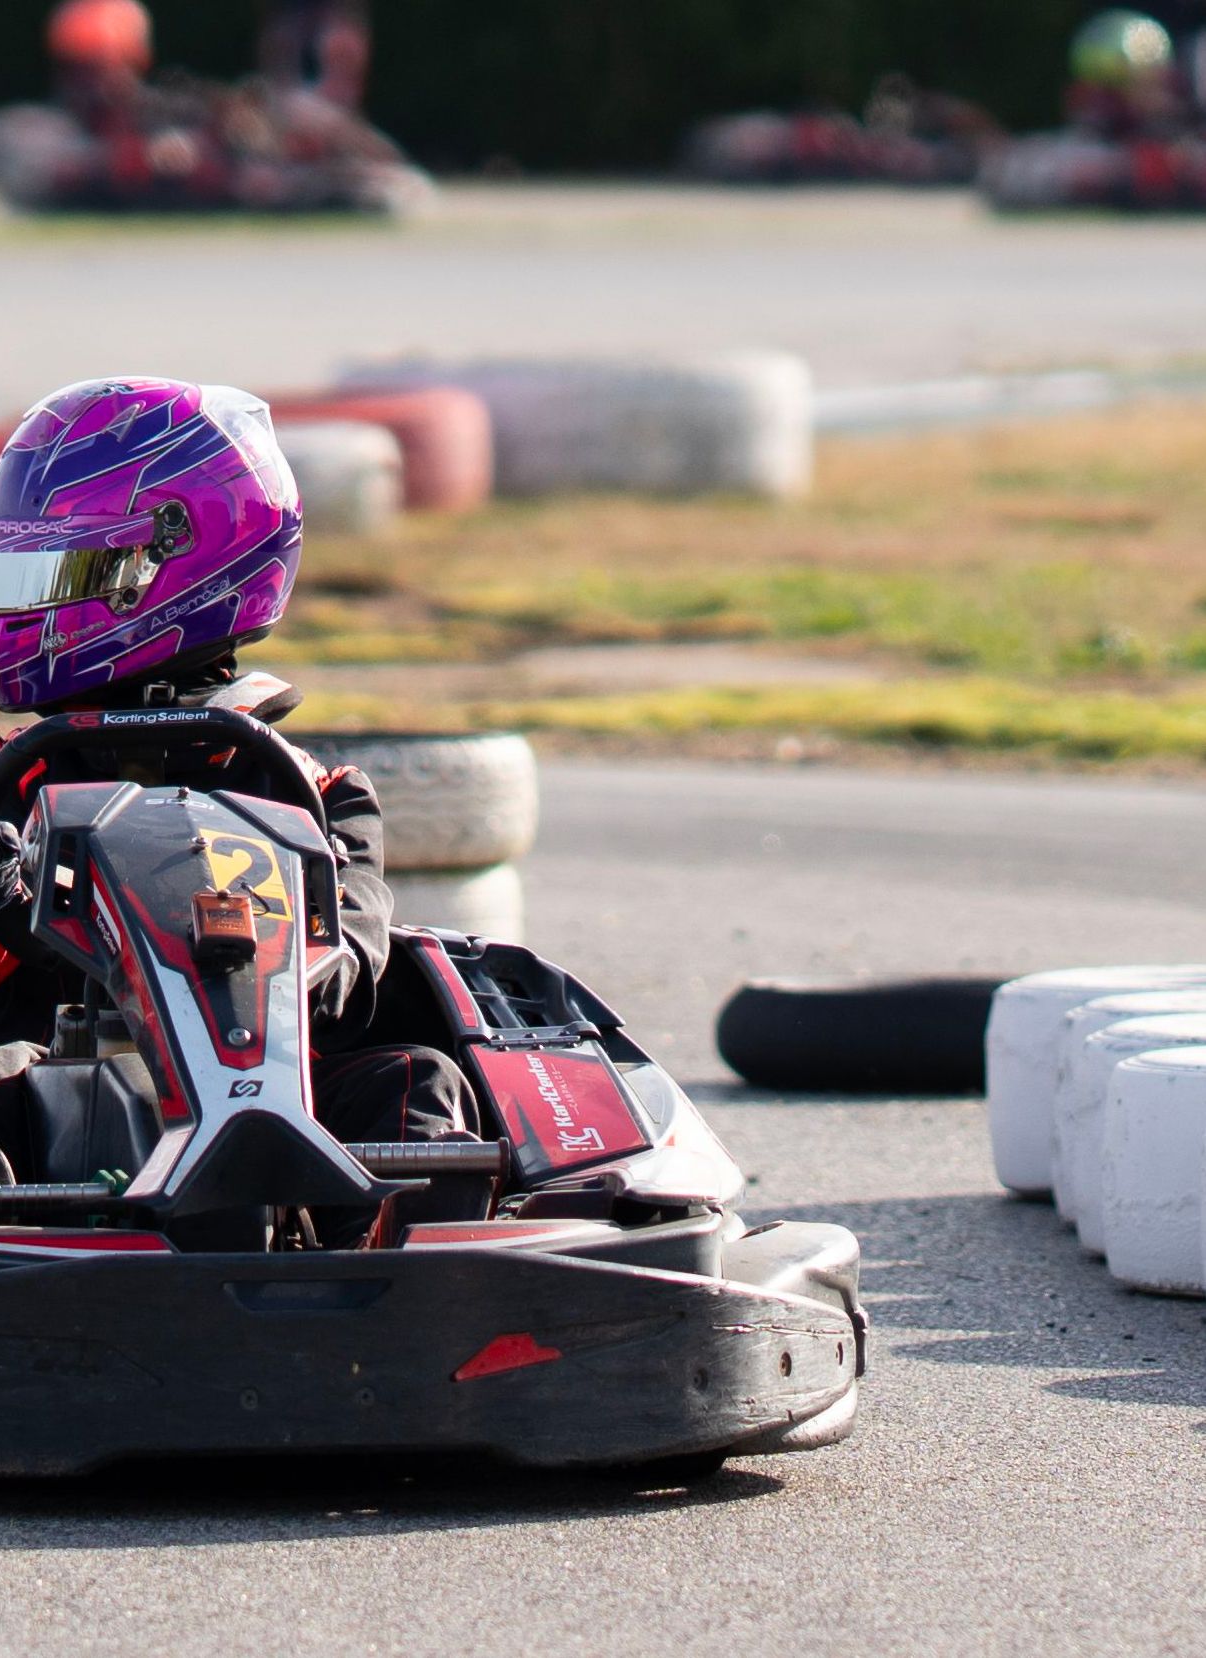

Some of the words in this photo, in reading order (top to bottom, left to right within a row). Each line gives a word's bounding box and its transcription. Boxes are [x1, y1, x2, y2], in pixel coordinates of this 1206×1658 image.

[103, 711, 210, 725] KartingSallent
[211, 836, 287, 917] 2
[526, 1053, 575, 1127] KartCenter
